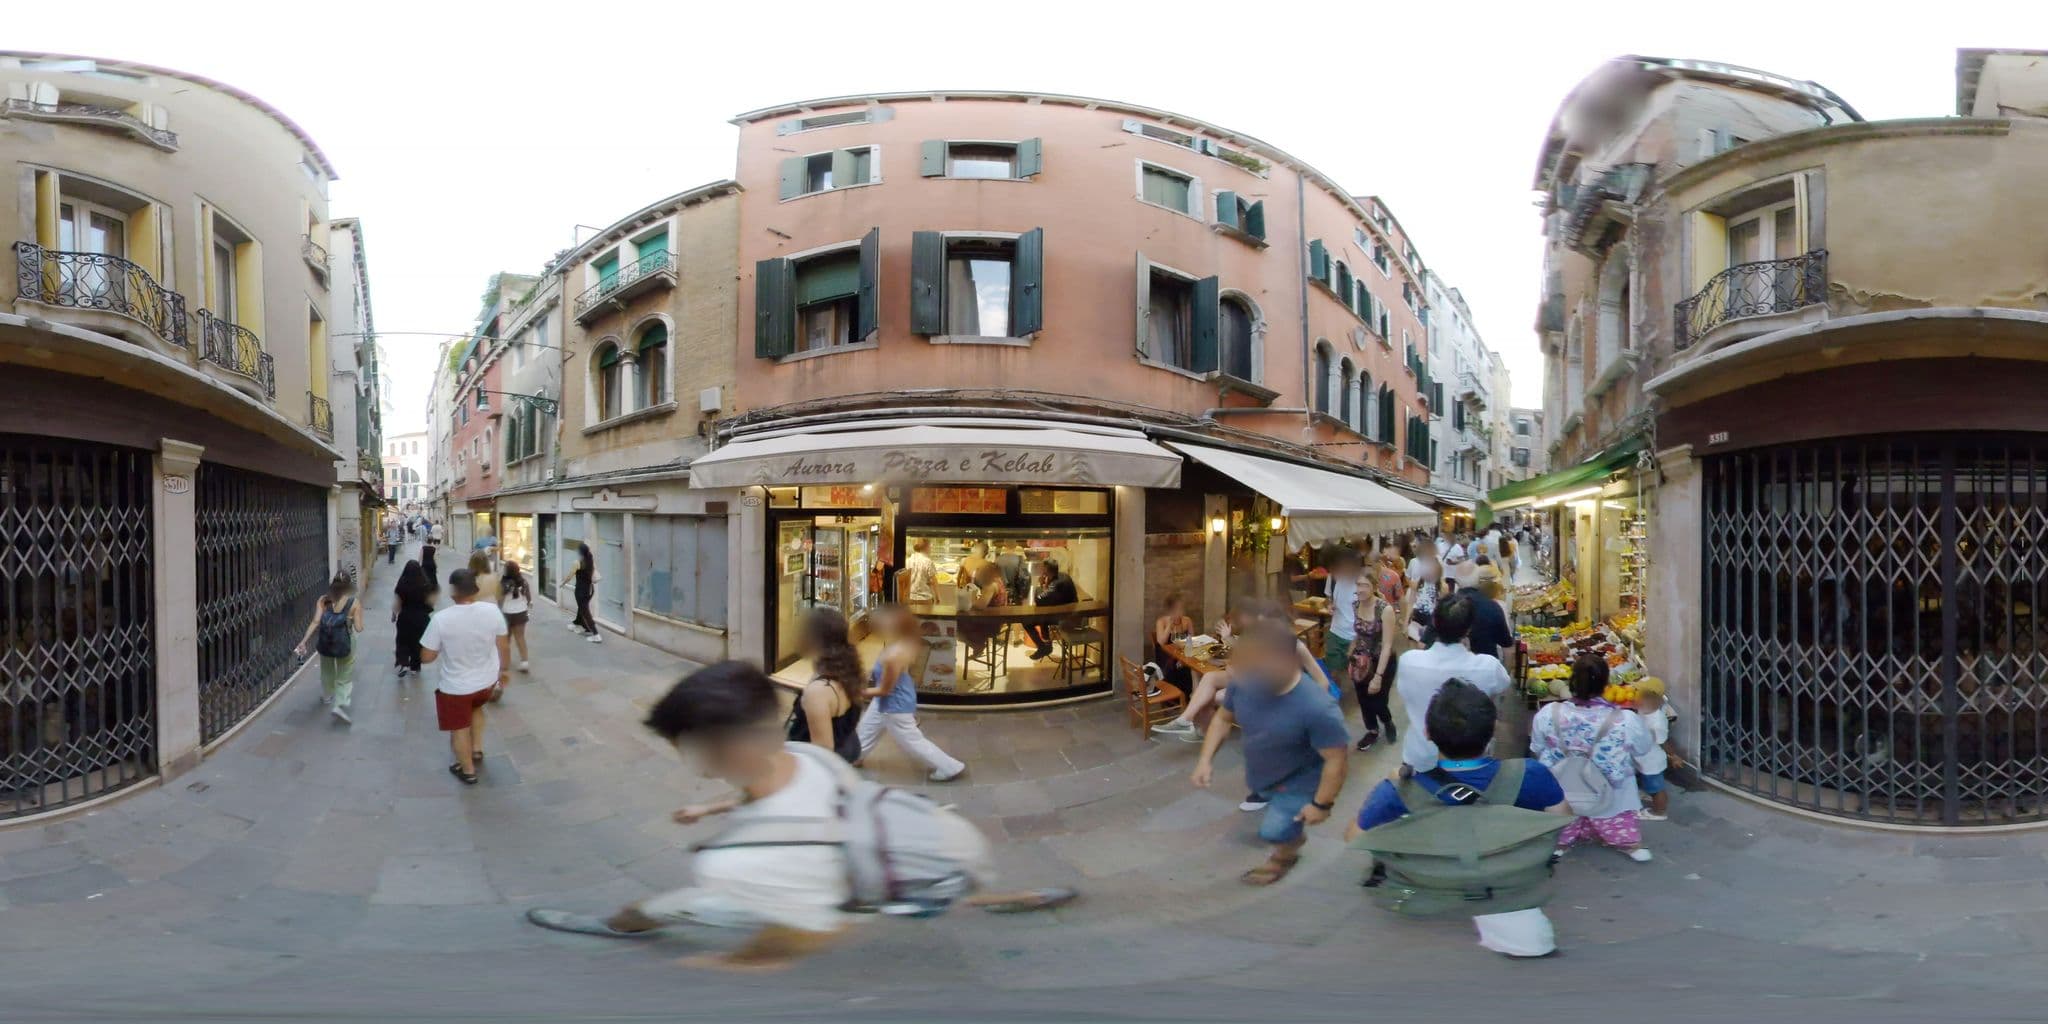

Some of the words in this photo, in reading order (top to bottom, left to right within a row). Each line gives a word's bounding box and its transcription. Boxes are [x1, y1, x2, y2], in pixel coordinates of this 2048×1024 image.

[784, 458, 857, 477] Aurora
[883, 451, 950, 481] Pizza
[959, 459, 972, 472] e
[980, 449, 1055, 474] Kebab
